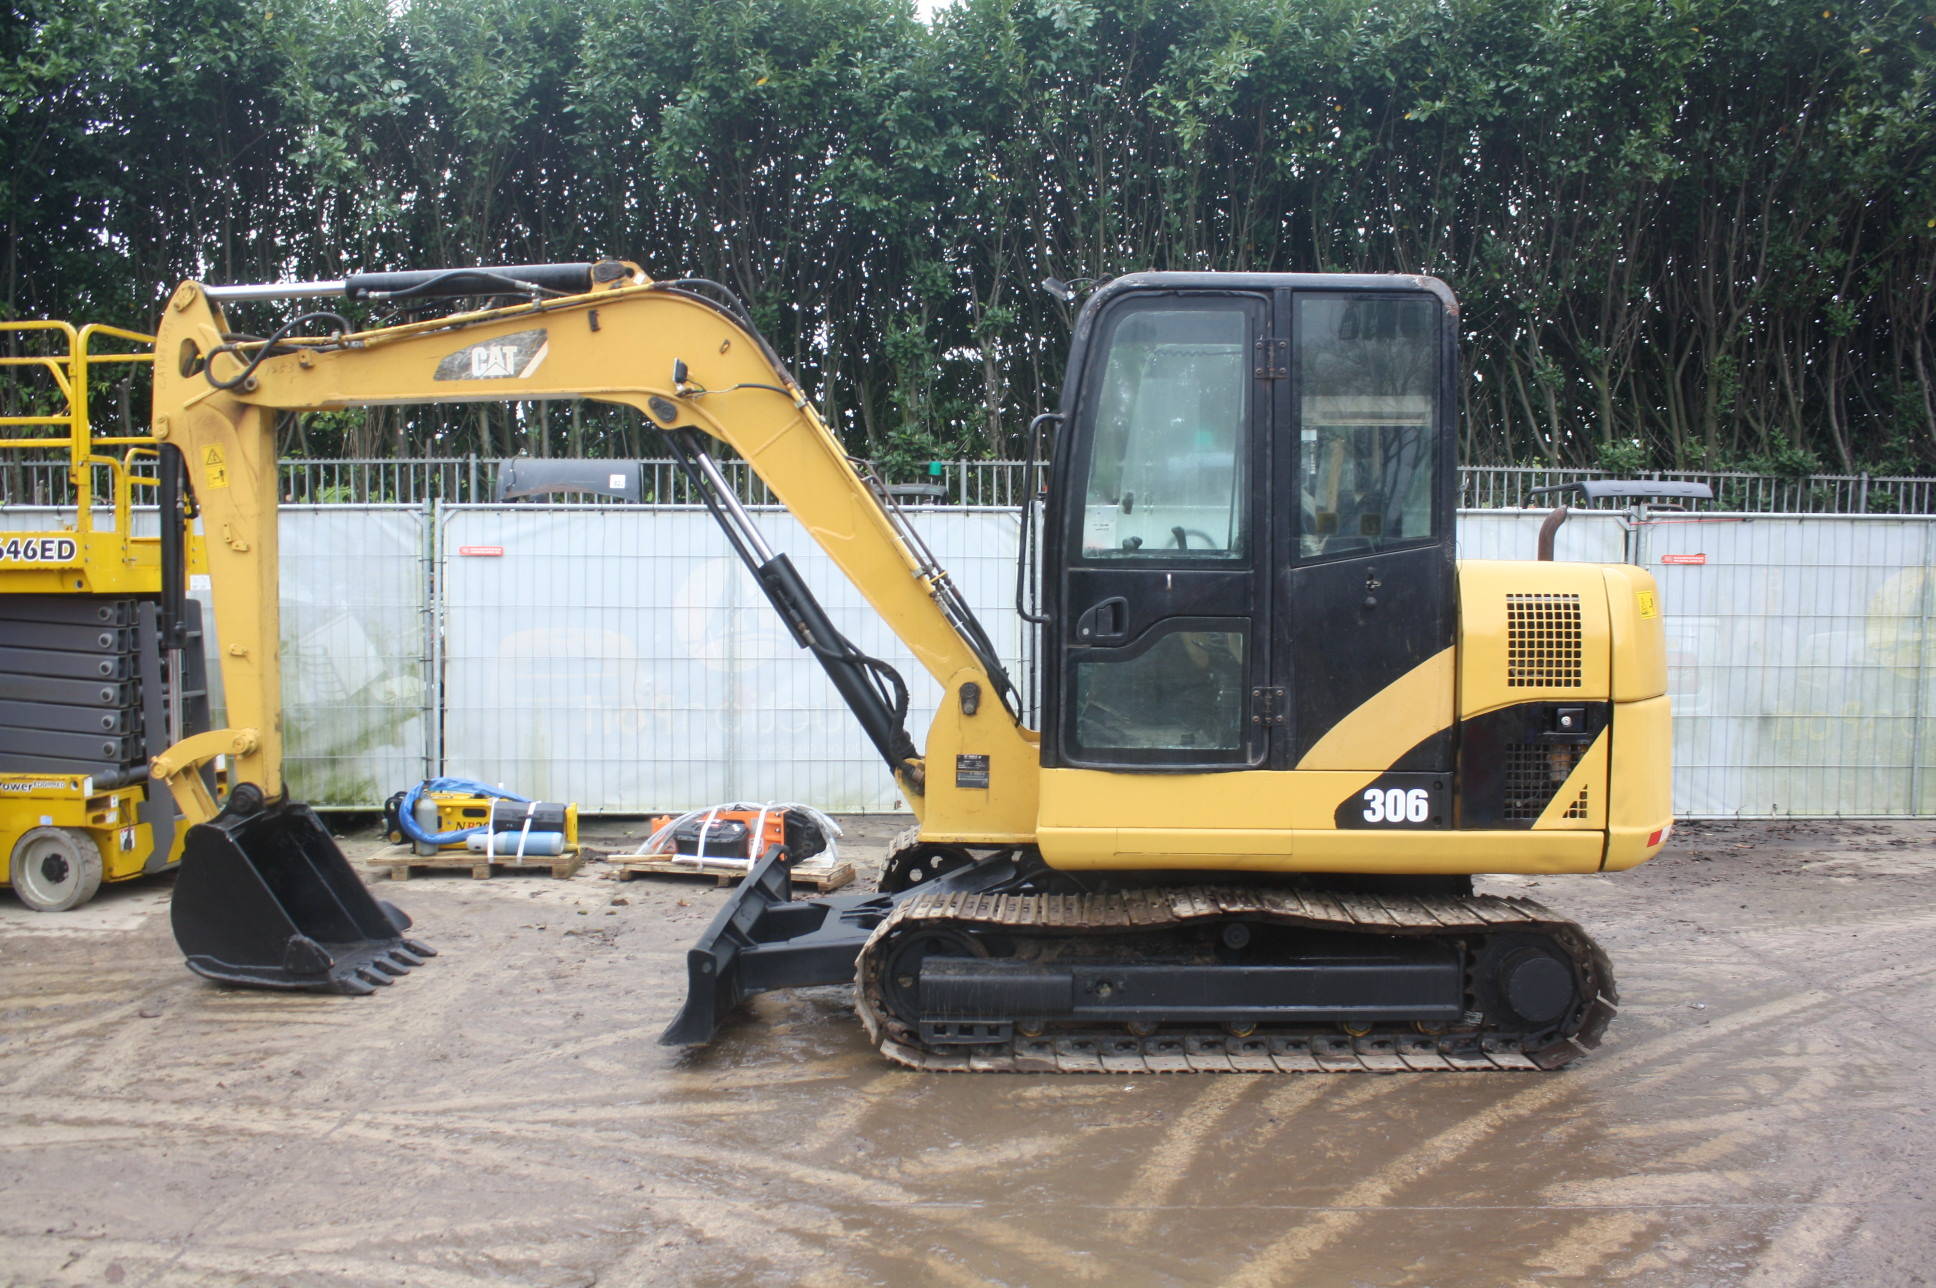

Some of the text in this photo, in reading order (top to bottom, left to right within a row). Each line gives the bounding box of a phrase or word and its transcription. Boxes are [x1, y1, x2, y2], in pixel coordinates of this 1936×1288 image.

[472, 345, 517, 377] CAT
[0, 539, 76, 561] 46ED
[0, 782, 32, 791] ower
[1363, 788, 1428, 822] 306
